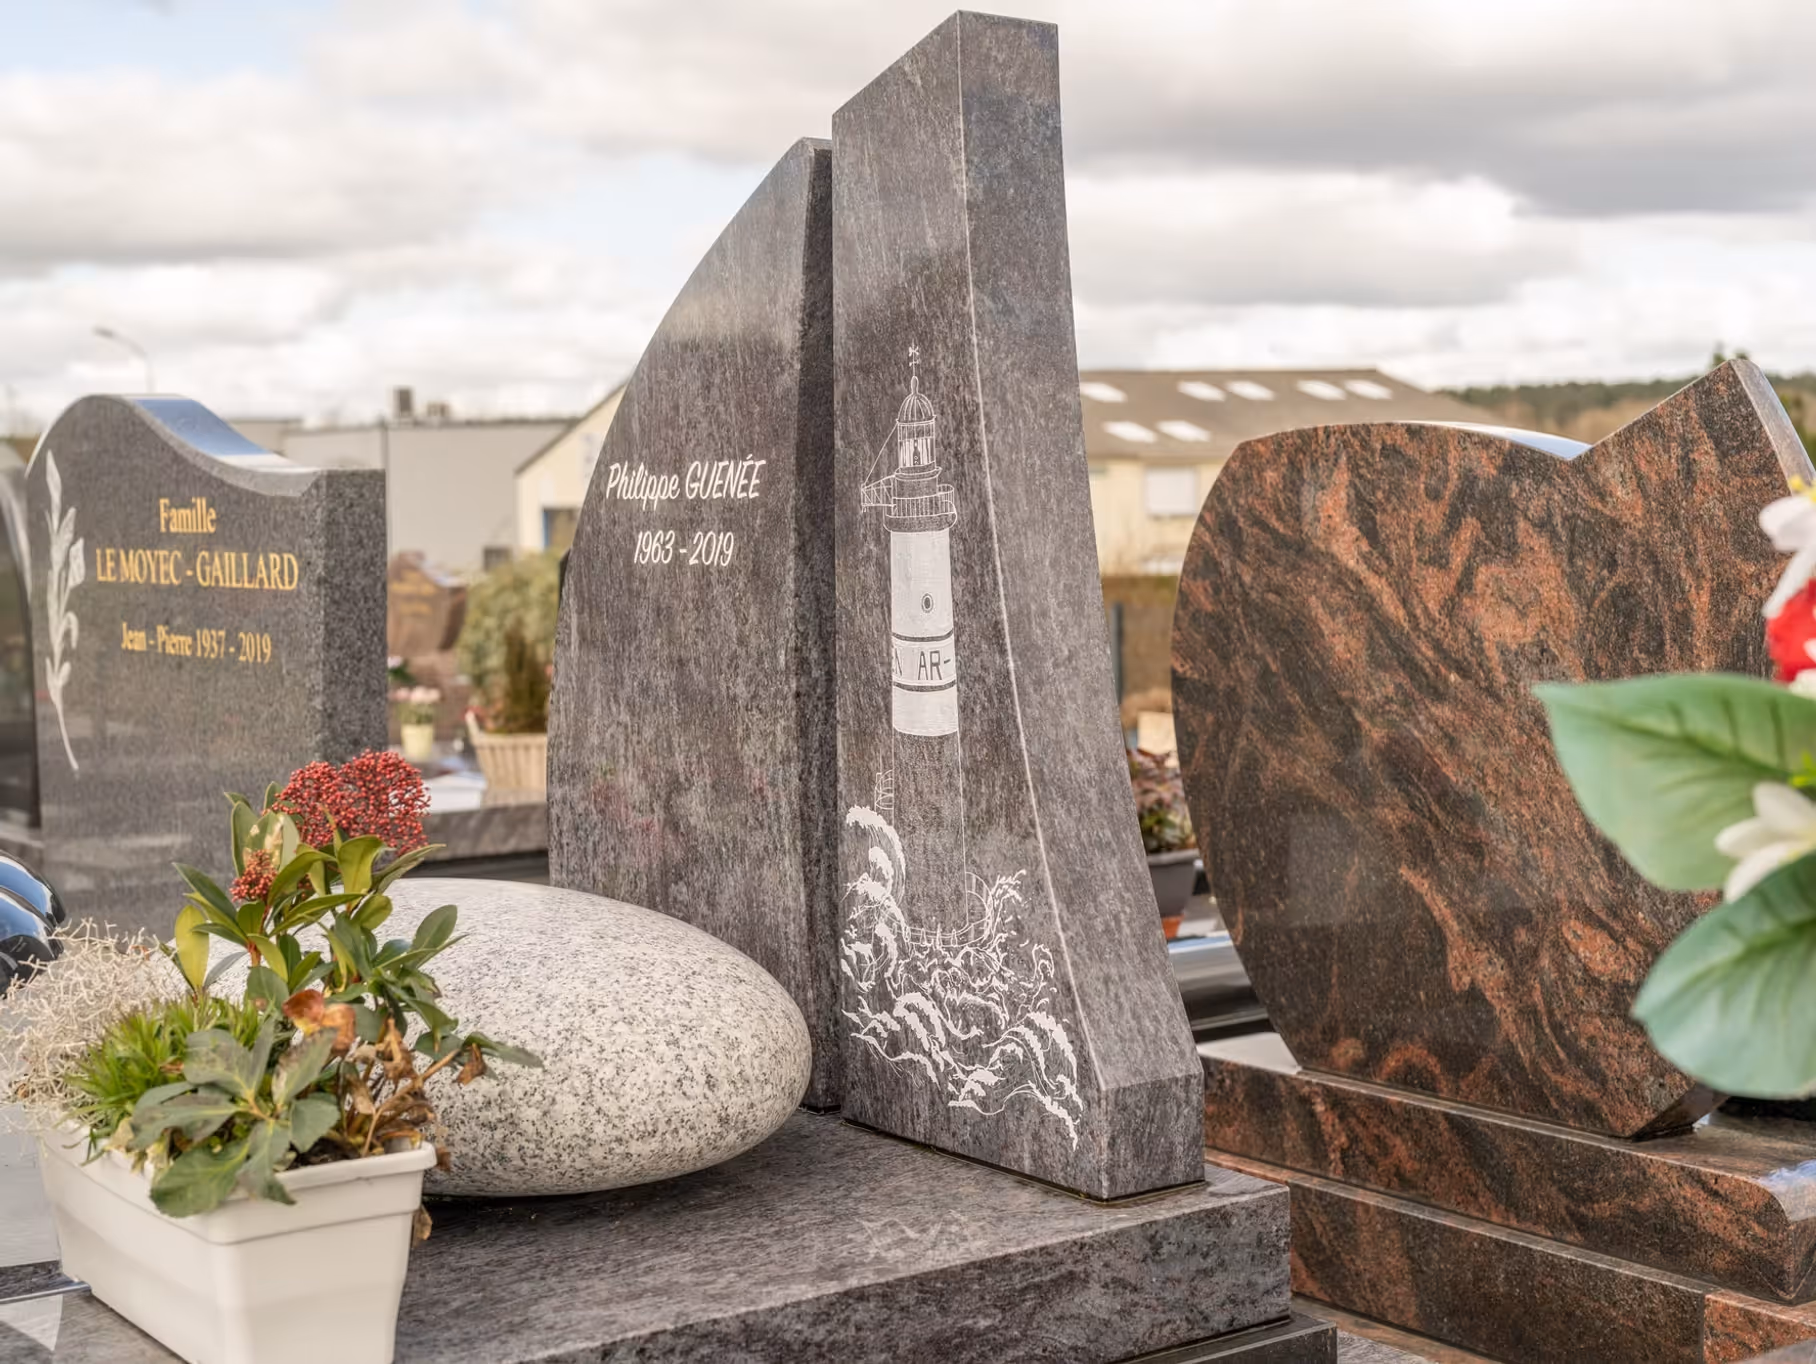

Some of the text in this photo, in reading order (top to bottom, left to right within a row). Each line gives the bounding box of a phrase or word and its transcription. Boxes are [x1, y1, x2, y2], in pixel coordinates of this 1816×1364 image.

[606, 454, 767, 511] Philippe GUENÉE
[159, 497, 217, 533] Famille
[634, 530, 675, 564] 1963
[689, 531, 734, 566] 2019
[96, 549, 116, 582] LE
[119, 549, 182, 585] MOYEC
[196, 551, 299, 590] GAILLARD
[121, 622, 147, 651] Jean
[156, 625, 193, 656] Pierre
[196, 628, 226, 658] 1937
[238, 632, 272, 663] 2019
